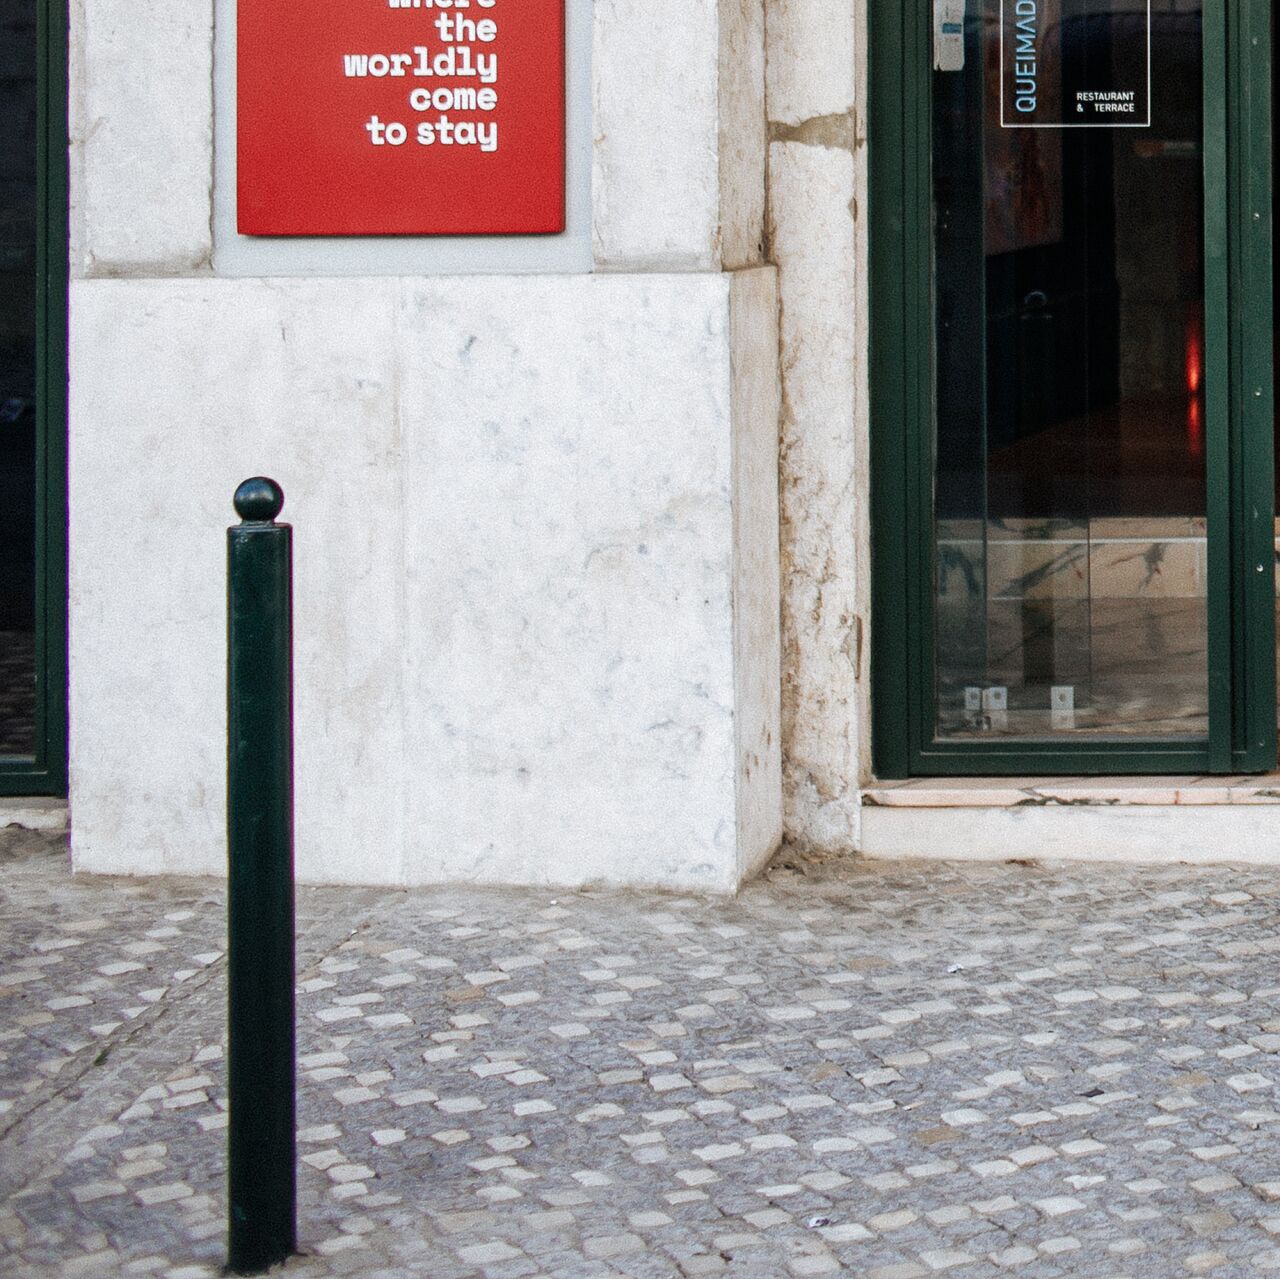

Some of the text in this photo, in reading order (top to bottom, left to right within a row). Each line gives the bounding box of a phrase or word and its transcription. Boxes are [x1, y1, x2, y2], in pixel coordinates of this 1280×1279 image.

[434, 11, 498, 42] the
[343, 45, 498, 84] worldly
[409, 87, 498, 112] come
[1076, 91, 1135, 102] RESTAURANT
[1076, 102, 1135, 113] & TERRACE
[365, 114, 498, 152] to stay
